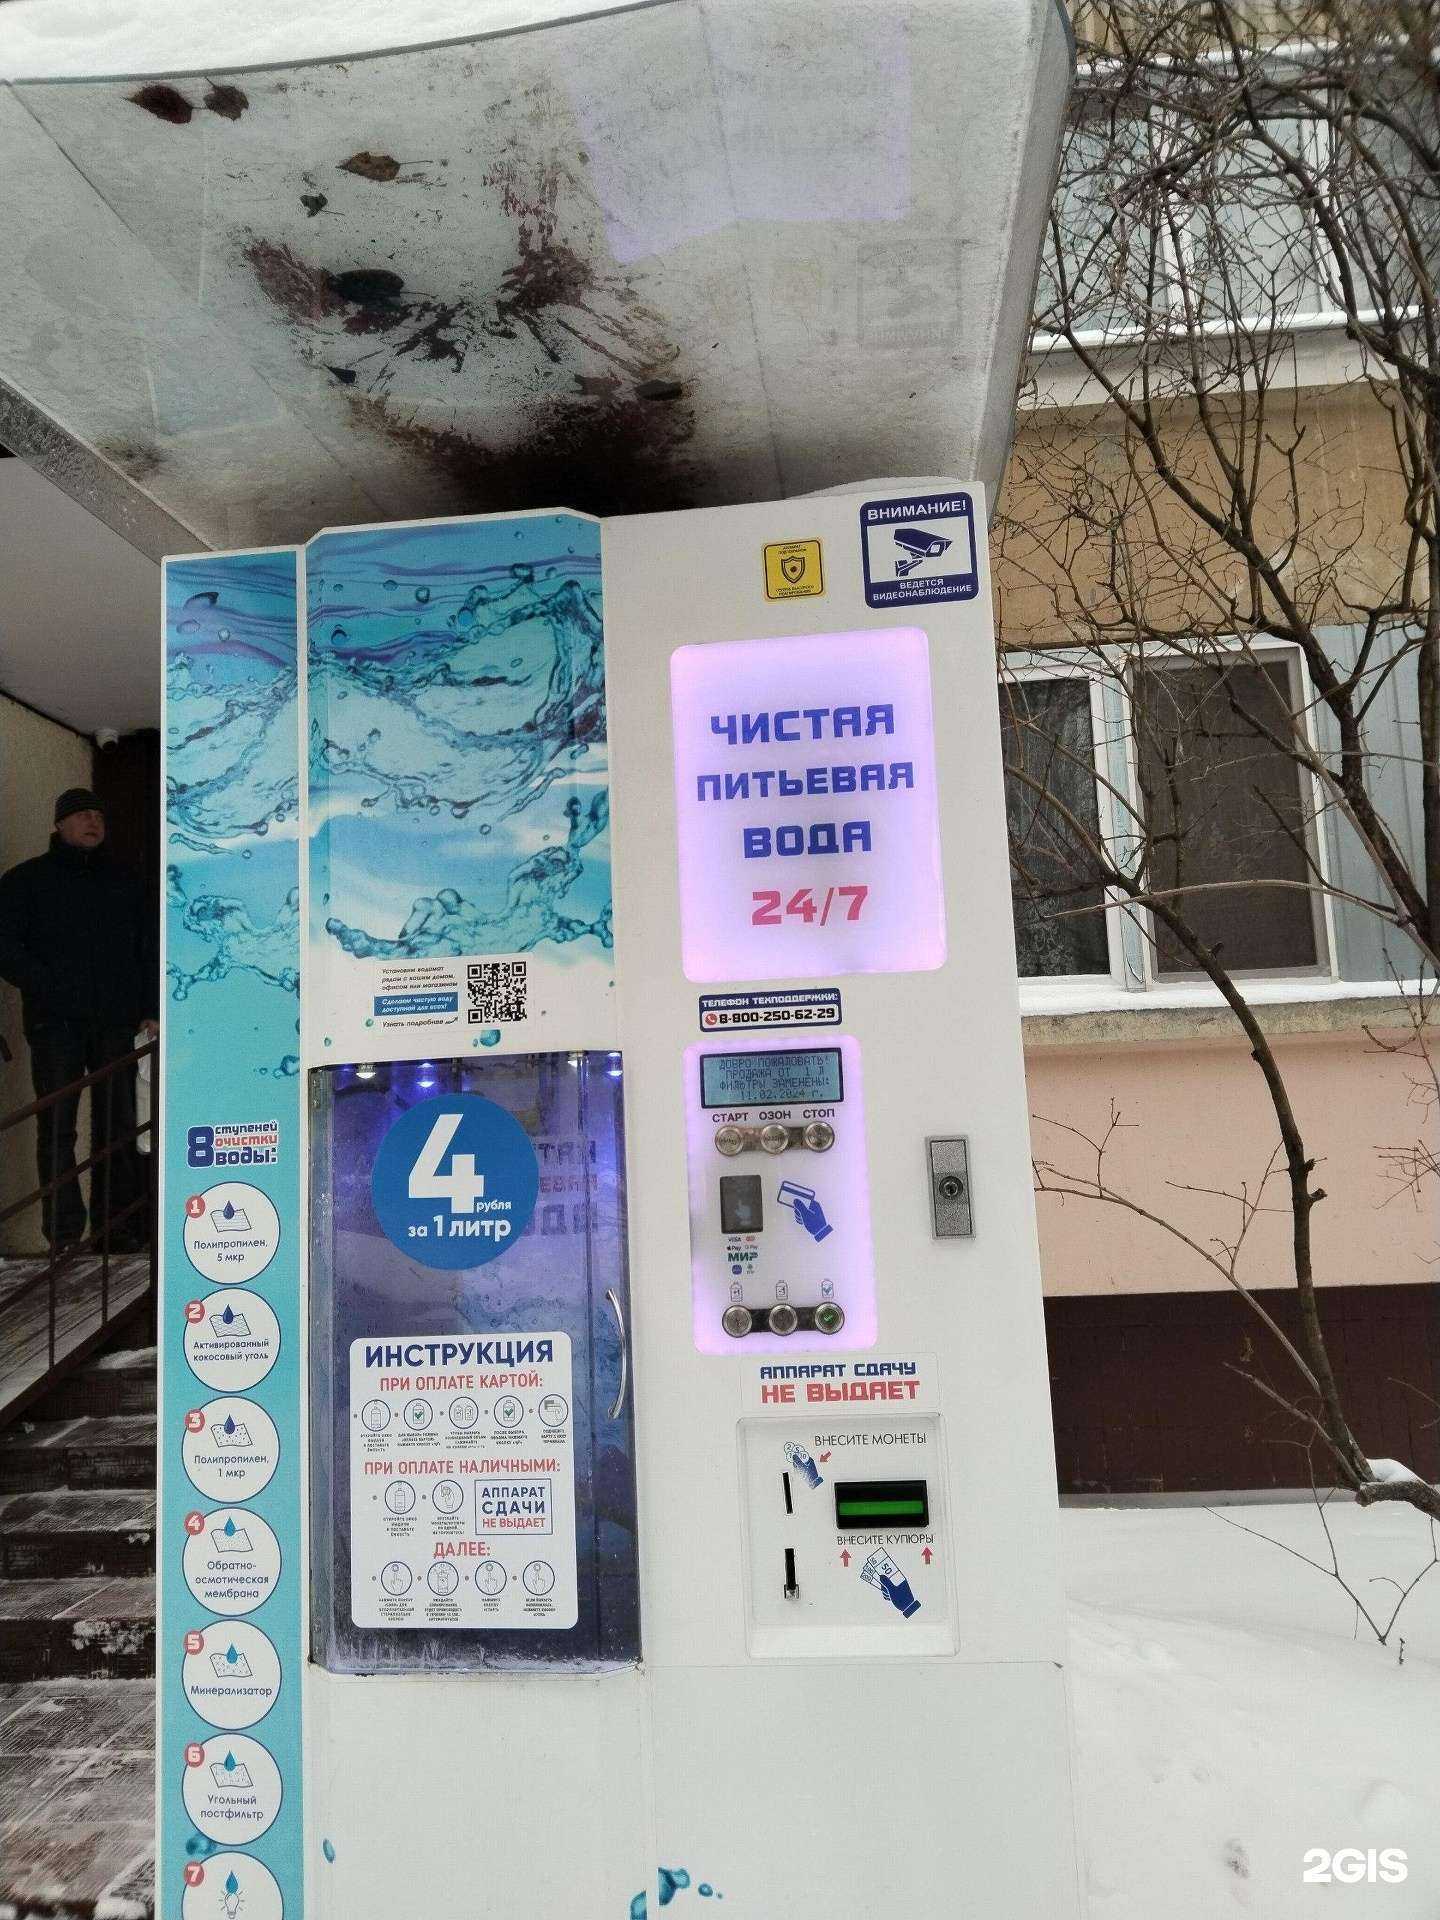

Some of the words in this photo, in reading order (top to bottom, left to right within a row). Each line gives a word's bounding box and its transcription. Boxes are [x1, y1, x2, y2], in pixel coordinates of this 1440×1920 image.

[867, 500, 966, 520] ВНИМАНИЕ!
[900, 578, 944, 590] ВЕДЕТСЯ
[873, 584, 972, 601] ВИДЕОНАБЛЮДЕНИЕ
[710, 704, 895, 745] ЧИСТАЯ
[697, 762, 914, 801] ПИТЬЕВАЯ
[743, 821, 872, 858] ВОДА
[752, 885, 868, 926] 24/7
[702, 998, 750, 1008] ТЕЛЕФОН
[752, 993, 839, 1005] ТЕХПОДДЕРЖКИ:
[719, 1007, 836, 1025] 8-800-250-62-29
[720, 1059, 752, 1071] ДОБРО
[725, 1068, 772, 1080] ПРОДАЖА
[778, 1068, 791, 1077] ОТ
[712, 1112, 749, 1123] СТАРТ
[759, 1110, 791, 1121] ОЗОН
[803, 1108, 835, 1119] СТОП
[188, 1126, 214, 1168] 8
[215, 1121, 278, 1135] ступеней
[215, 1134, 277, 1147] очистки
[215, 1147, 277, 1166] воды:
[408, 1113, 485, 1213] 4
[191, 1199, 200, 1214] 1
[477, 1200, 512, 1213] рубля
[408, 1224, 428, 1238] за
[433, 1215, 444, 1237] 1
[449, 1218, 512, 1242] литр
[194, 1239, 268, 1250] Полипропилен,
[217, 1253, 223, 1262] 5
[224, 1255, 244, 1263] мкр
[728, 1252, 758, 1262] МИР
[188, 1304, 201, 1319] 2
[193, 1339, 269, 1350] Активированный
[193, 1352, 243, 1362] кокосовый
[244, 1352, 269, 1362] уголь
[365, 1340, 553, 1368] ИНСТРУКЦИЯ
[760, 1364, 846, 1379] АППАРАТ
[854, 1362, 916, 1376] СДАЧУ
[380, 1377, 410, 1392] ПРИ
[416, 1375, 474, 1391] ОПЛАТЕ
[480, 1370, 543, 1389] КАРТОЙ:
[762, 1384, 795, 1403] НЕ
[806, 1381, 920, 1403] ВЫДАЕТ
[188, 1413, 201, 1428] 3
[814, 1434, 869, 1447] ВНЕСИТЕ
[872, 1433, 927, 1446] МОНЕТЫ
[194, 1455, 269, 1465] Полипропилен,
[364, 1461, 393, 1476] ПРИ
[398, 1460, 454, 1475] ОПЛАТЕ
[459, 1457, 561, 1474] НАЛИЧНЫМИ:
[218, 1468, 222, 1477] 1
[225, 1470, 245, 1480] мкр
[481, 1487, 545, 1498] АППАРАТ
[481, 1501, 545, 1516] СДАЧИ
[188, 1515, 200, 1530] 4
[482, 1518, 497, 1528] НЕ
[499, 1517, 546, 1529] ВЫДАЕТ
[837, 1535, 884, 1546] ВНЕСИТЕ
[886, 1533, 934, 1545] КУПЮРЫ
[433, 1541, 491, 1559] ДАЛЕЕ:
[207, 1560, 257, 1572] Обратно-
[881, 1562, 893, 1575] 50
[195, 1575, 269, 1585] осмотическая
[204, 1588, 259, 1600] мембрана
[187, 1635, 200, 1650] 5
[190, 1686, 272, 1698] Минерализатор
[188, 1747, 200, 1763] 6
[208, 1794, 257, 1806] Угольный
[200, 1810, 264, 1822] постфильтр
[187, 1867, 200, 1883] 7
